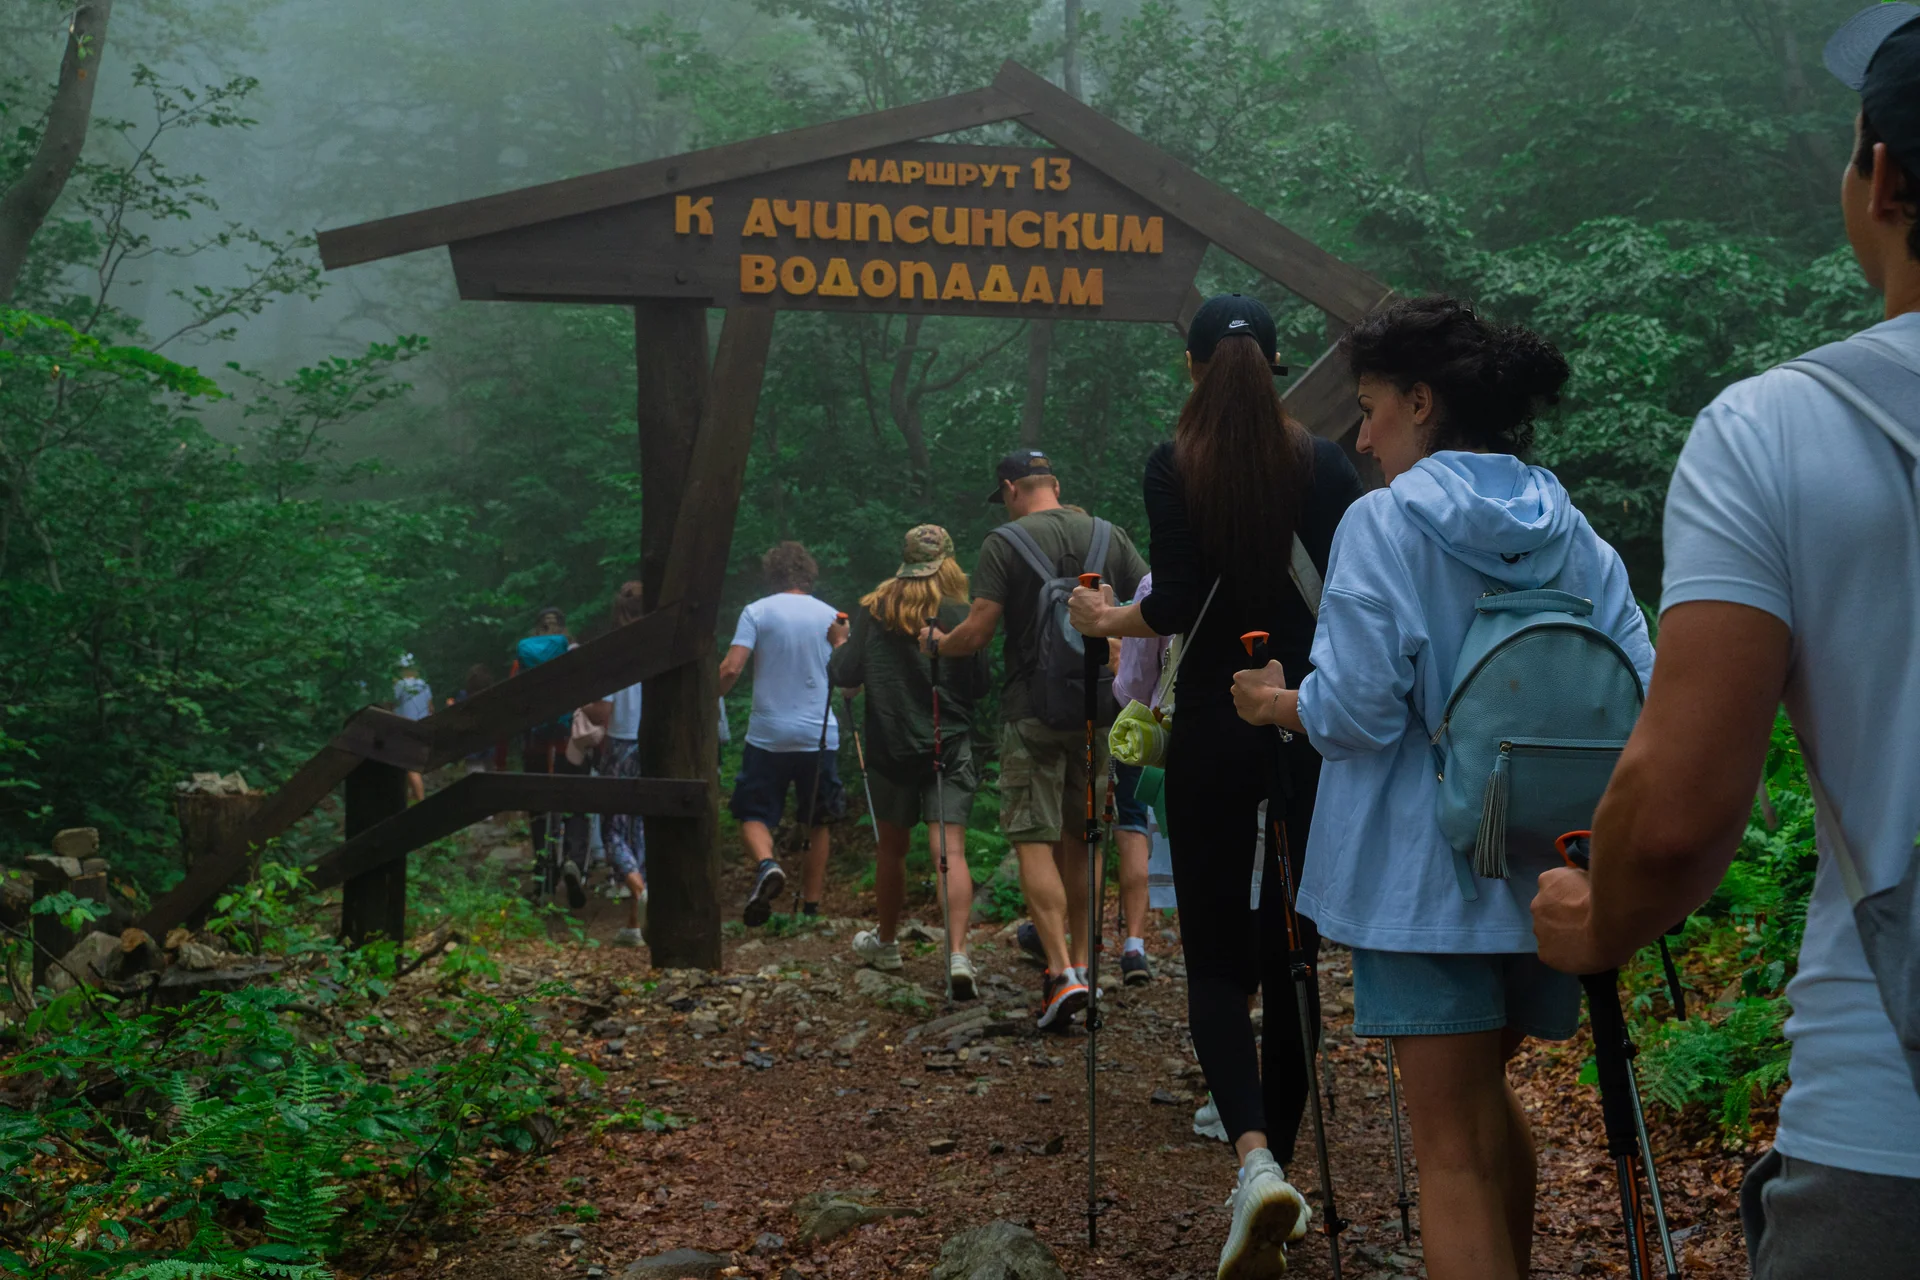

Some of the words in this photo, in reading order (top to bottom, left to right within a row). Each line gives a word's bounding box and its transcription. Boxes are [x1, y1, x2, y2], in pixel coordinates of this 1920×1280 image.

[847, 158, 1021, 188] МАРШРУТ
[1031, 157, 1072, 190] 13
[674, 195, 714, 235] К
[741, 198, 1164, 254] АЧИПСИНСКИМ
[740, 254, 1104, 306] ВОДОПАДАМ
